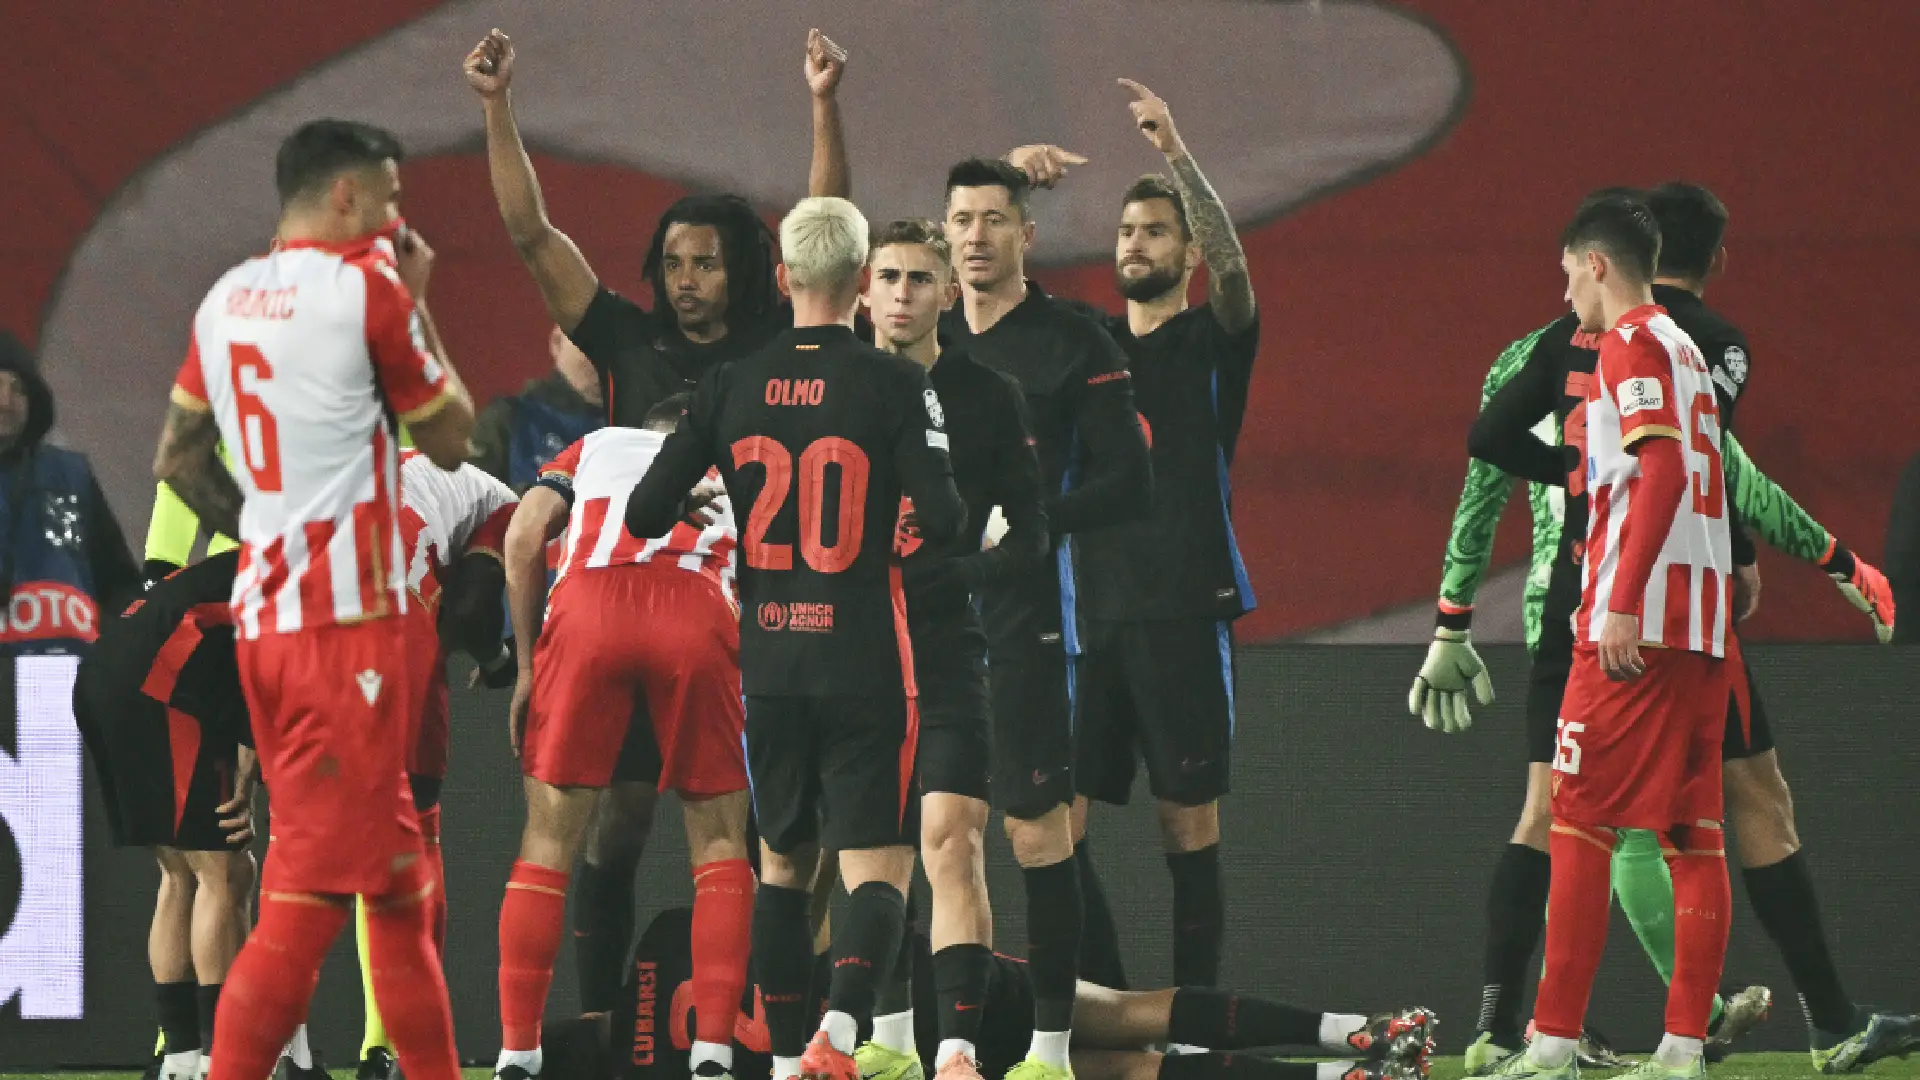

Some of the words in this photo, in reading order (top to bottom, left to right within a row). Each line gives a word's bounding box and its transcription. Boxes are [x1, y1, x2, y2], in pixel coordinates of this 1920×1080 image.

[764, 378, 826, 406] OLMO
[228, 342, 282, 493] 6
[730, 435, 871, 573] 20
[789, 602, 834, 615] UNHCR
[789, 614, 834, 627] ACNUR
